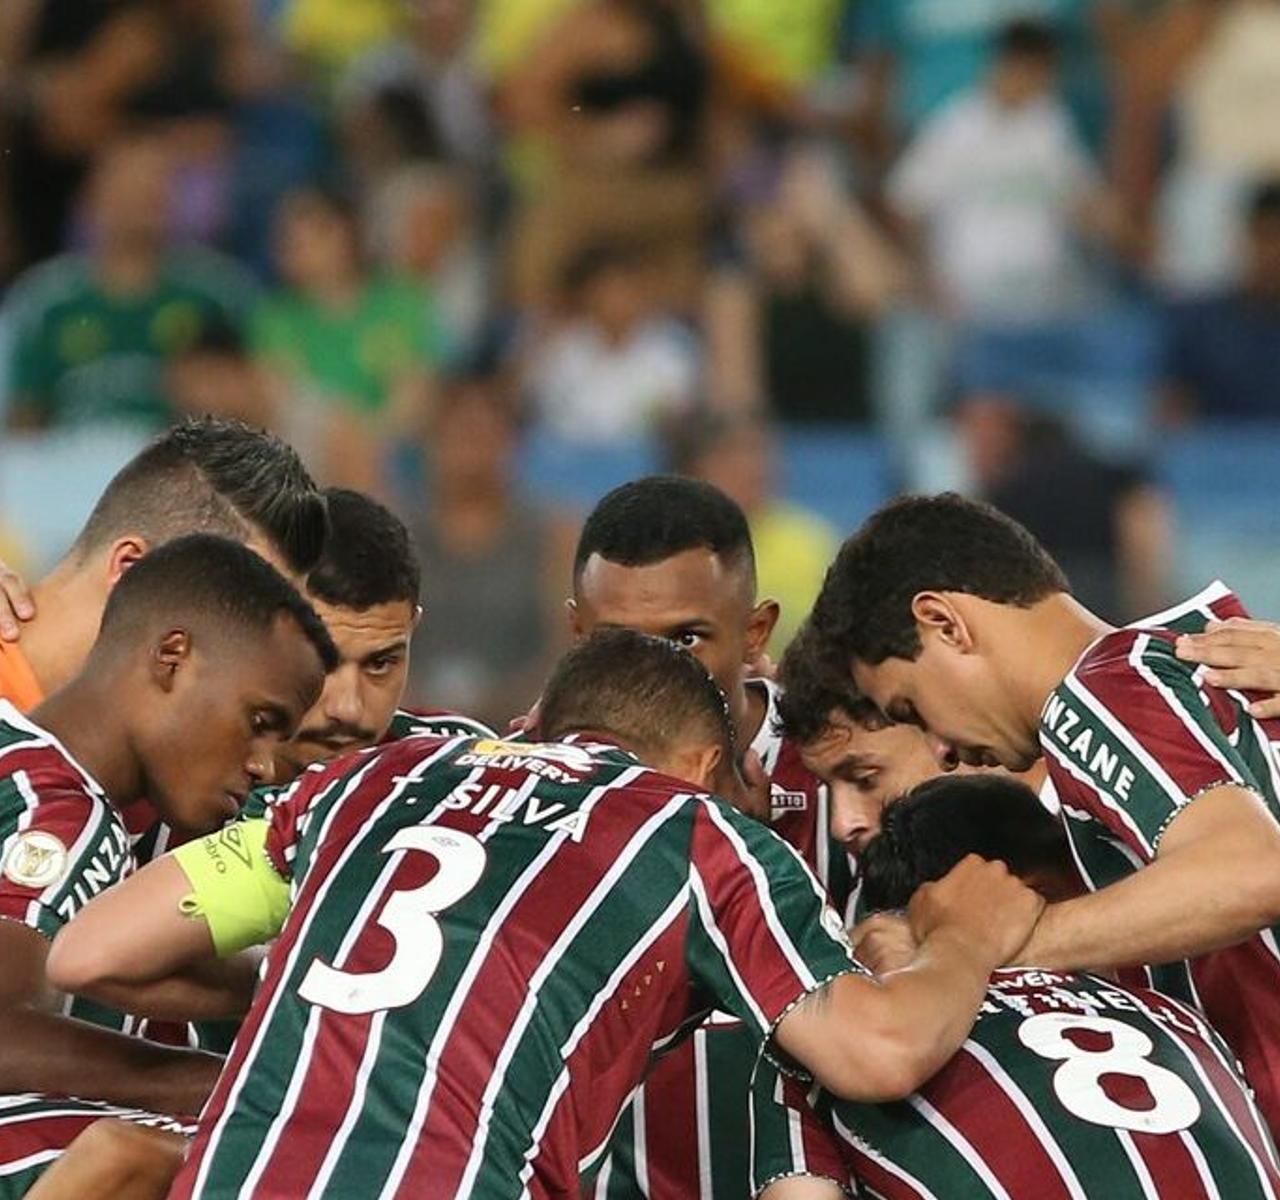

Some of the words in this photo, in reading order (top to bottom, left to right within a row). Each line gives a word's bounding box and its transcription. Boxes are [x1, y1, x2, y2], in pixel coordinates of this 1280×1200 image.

[442, 784, 590, 843] SILVA
[454, 753, 581, 784] DELIVERY
[297, 824, 488, 1015] 3
[1018, 1011, 1202, 1136] 8
